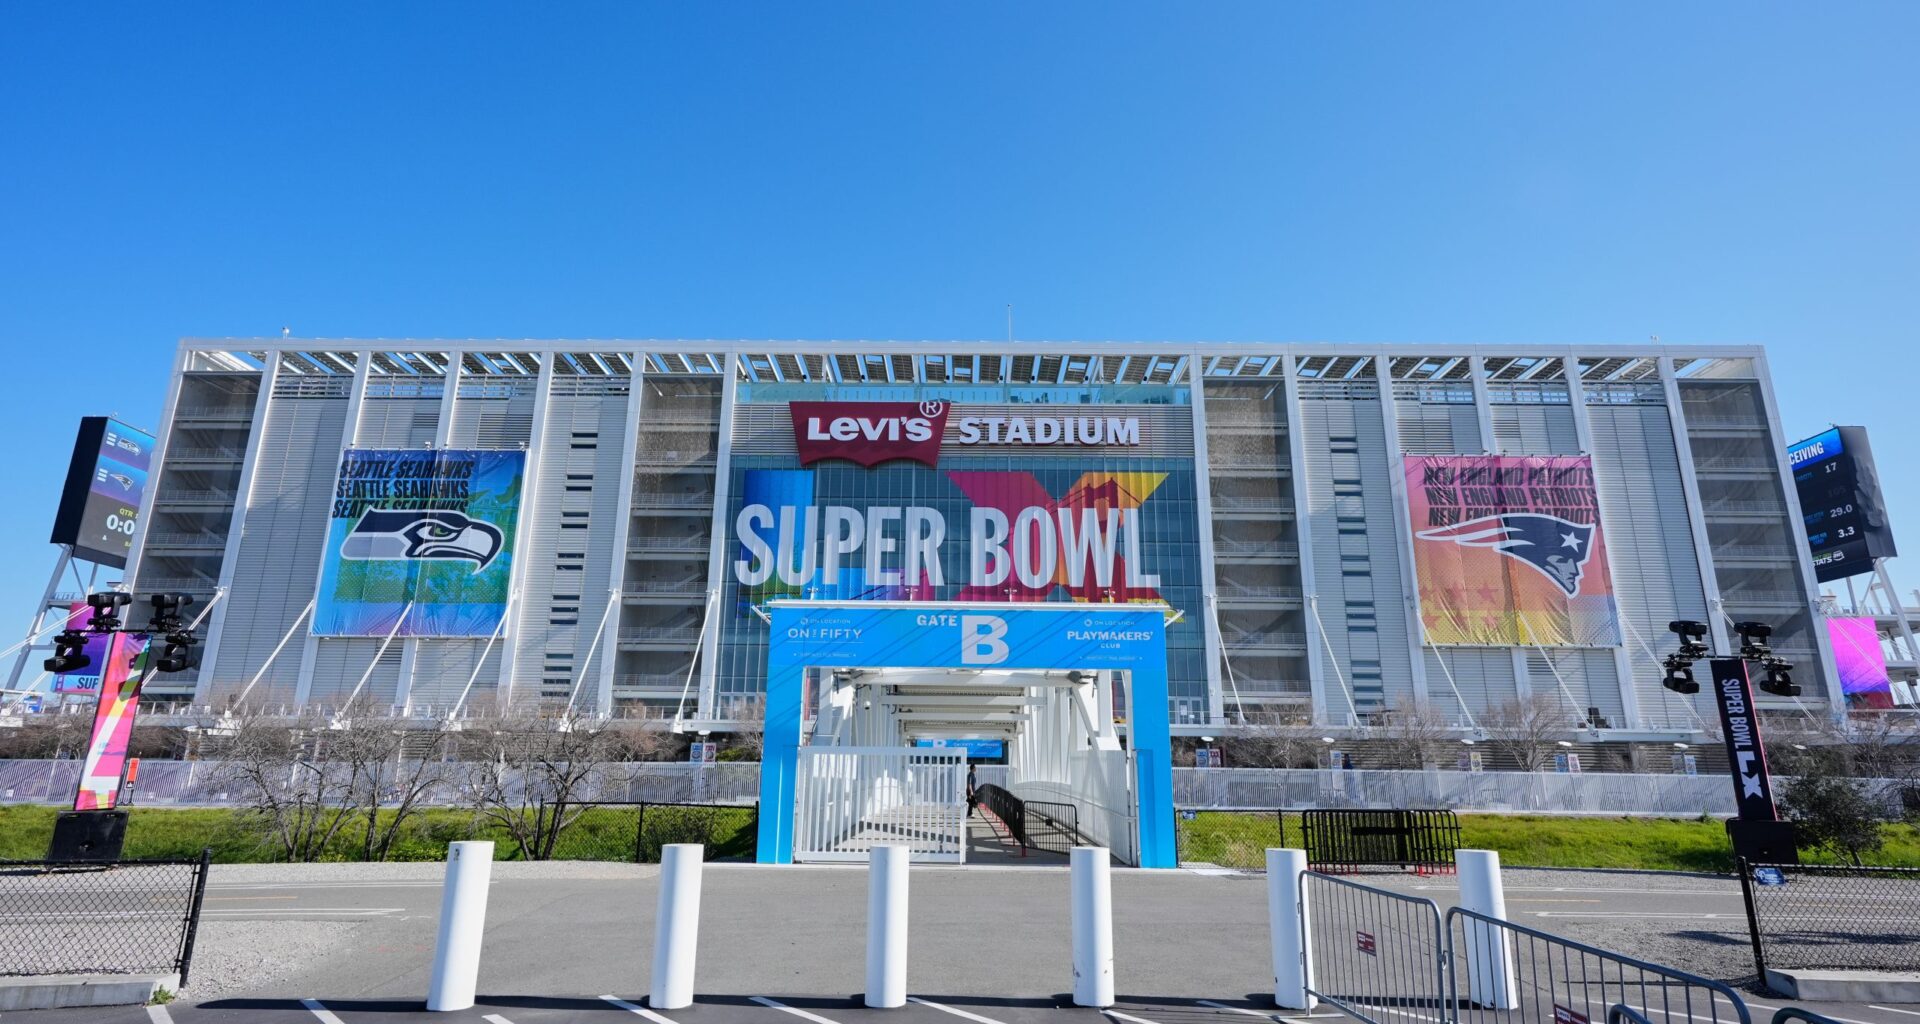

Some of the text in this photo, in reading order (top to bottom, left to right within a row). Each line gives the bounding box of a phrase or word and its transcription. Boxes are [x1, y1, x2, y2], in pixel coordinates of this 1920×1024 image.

[959, 417, 1140, 446] STADIUM
[340, 460, 474, 478] SEATTLE SEAHAWKS
[1423, 467, 1594, 486] NEW ENGLAND PATRIOTS
[1825, 462, 1837, 473] 17
[336, 480, 469, 498] SEATTLE SEAHAWKS
[1425, 487, 1599, 506] NEW ENGLAND PATRIOTS
[120, 508, 133, 518] QTR
[1830, 504, 1853, 517] 29.0
[1838, 526, 1855, 538] 3.3
[734, 504, 1161, 588] SUPER BOWL
[787, 628, 810, 638] ON
[820, 628, 862, 638] FIFTY
[916, 615, 1009, 664] GATE B
[1067, 631, 1153, 641] PLAYMAKERS'
[1721, 679, 1763, 799] SUPER BOWL LX
